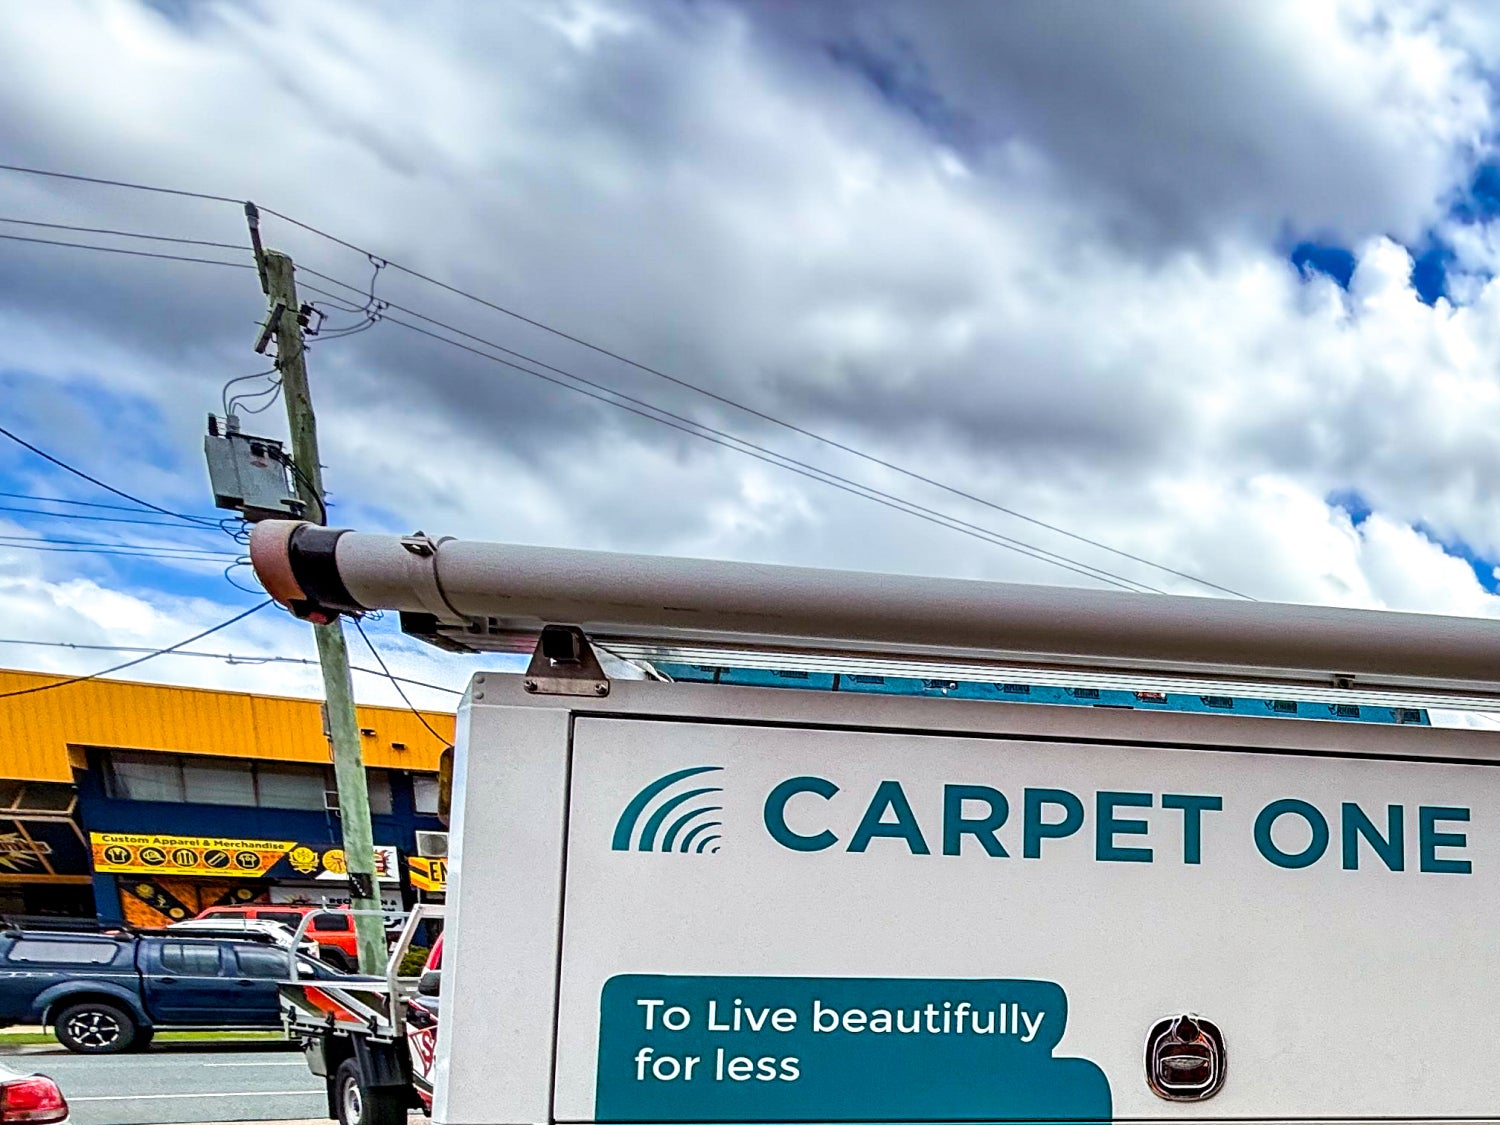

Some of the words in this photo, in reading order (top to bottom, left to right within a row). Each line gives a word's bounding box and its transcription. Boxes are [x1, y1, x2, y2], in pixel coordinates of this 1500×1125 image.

[101, 834, 149, 844] Custom
[152, 836, 199, 849] Apparel
[203, 839, 210, 847] &
[213, 839, 285, 850] Merchandise
[763, 776, 1223, 865] CARPET
[1253, 798, 1473, 875] ONE
[636, 998, 692, 1032] To
[707, 997, 798, 1033] Live
[812, 998, 1046, 1043] beautifully
[634, 1047, 701, 1082] for
[715, 1047, 801, 1082] less
